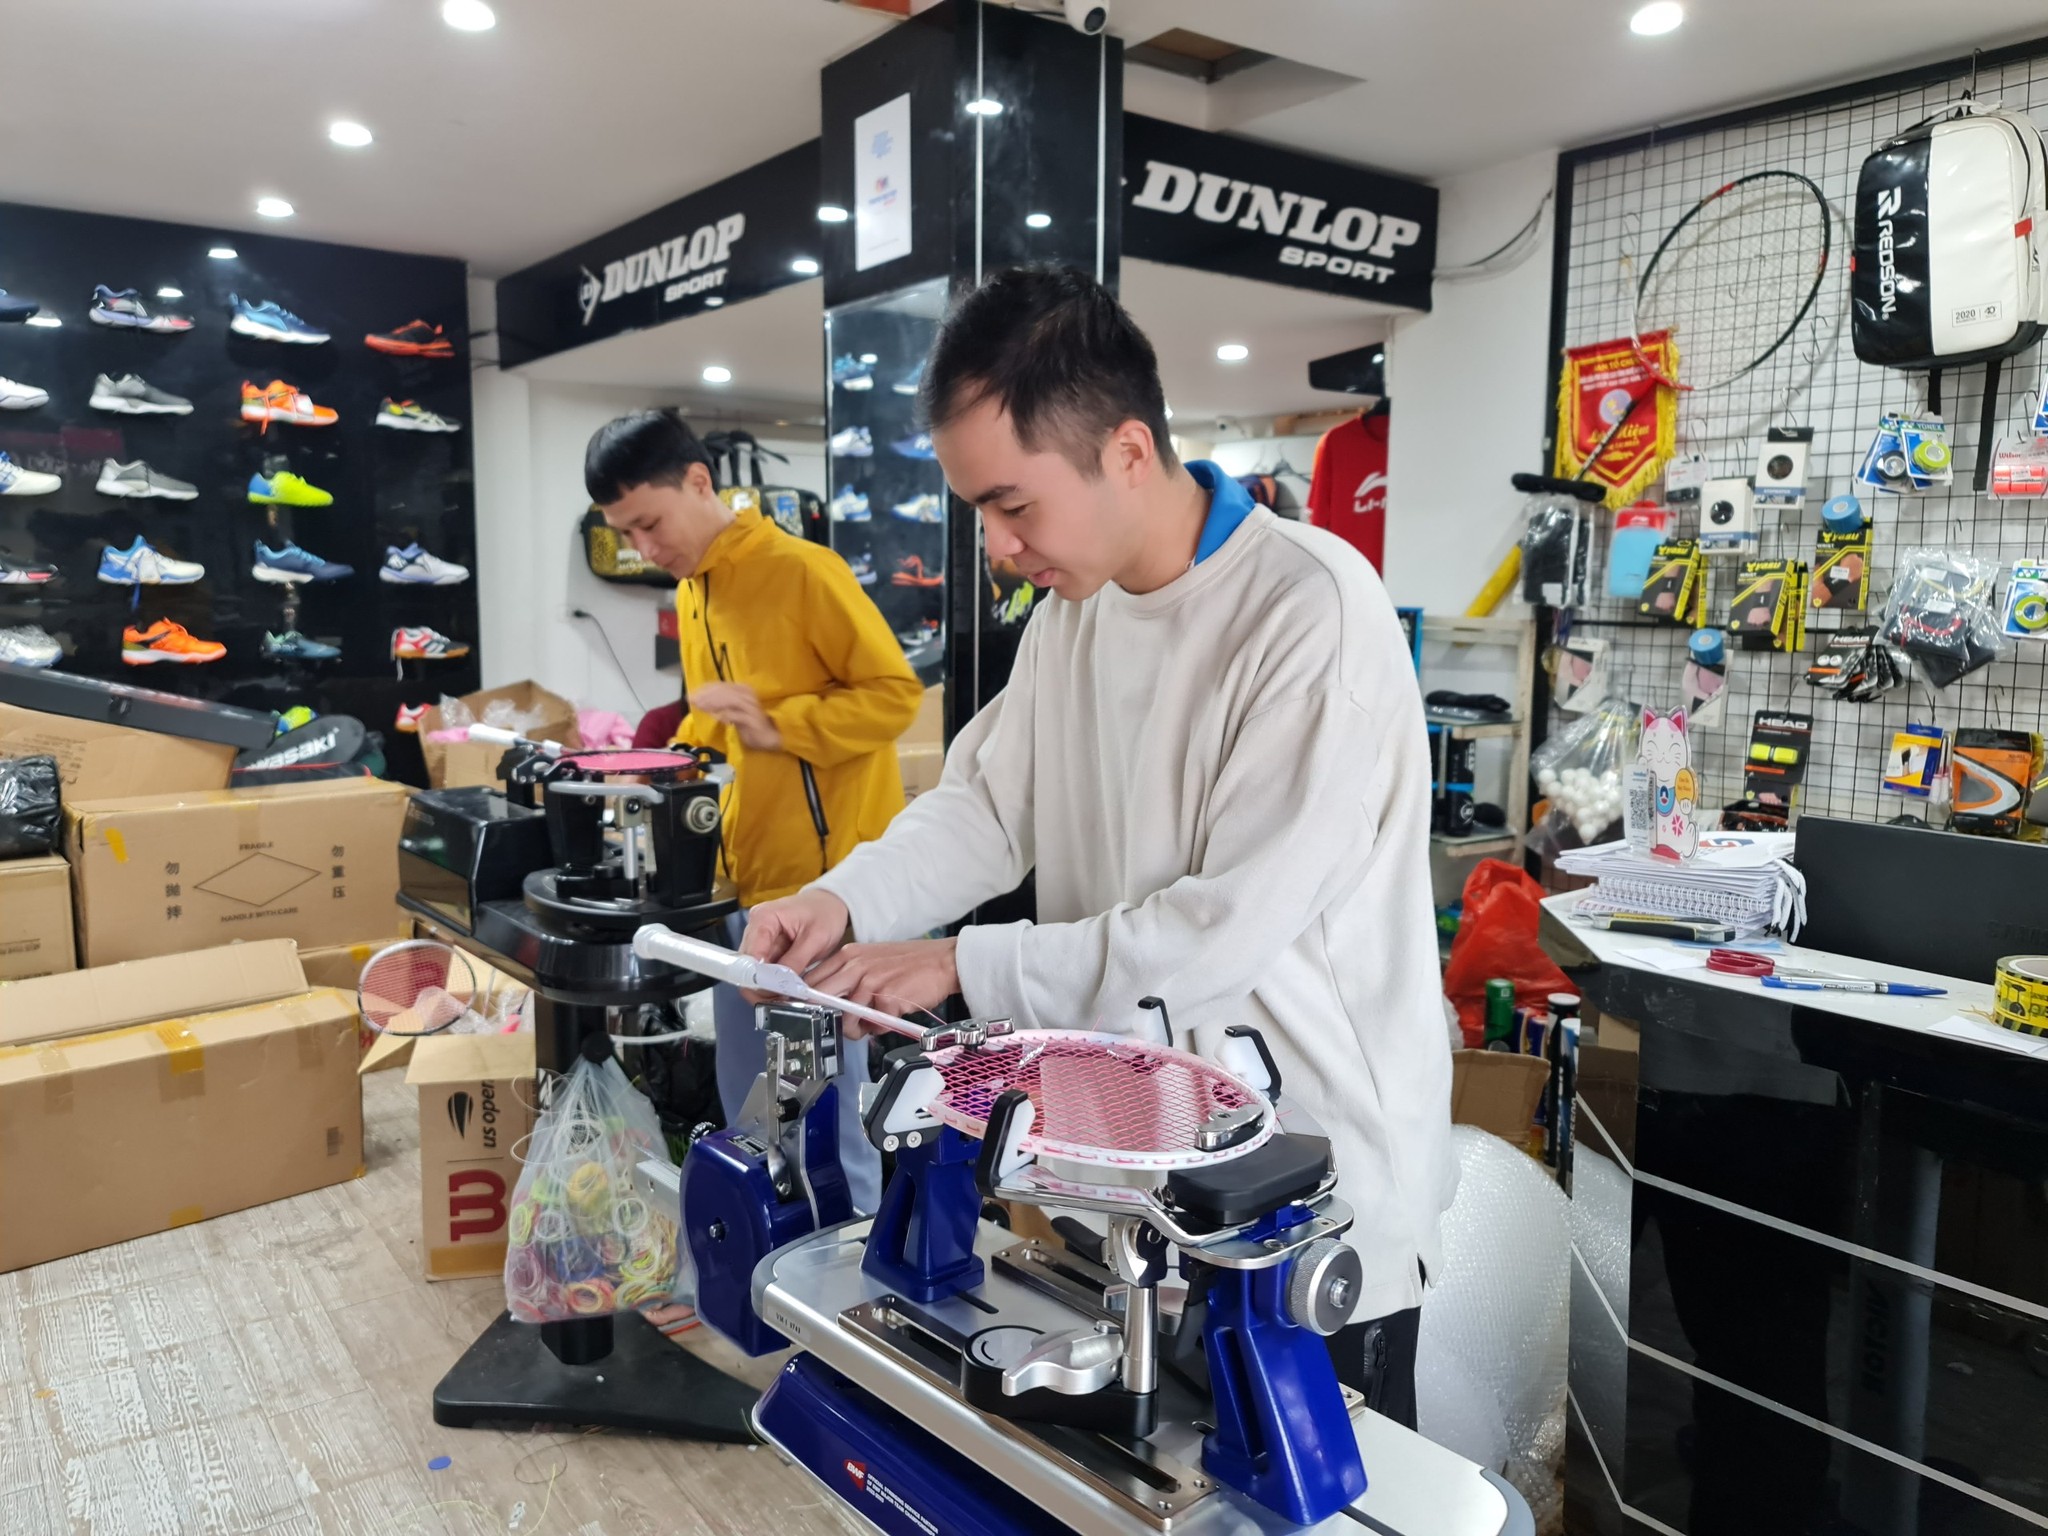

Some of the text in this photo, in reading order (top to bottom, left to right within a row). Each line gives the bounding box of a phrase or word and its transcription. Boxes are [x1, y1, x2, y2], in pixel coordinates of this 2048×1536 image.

[1132, 160, 1421, 258] DUNLOP
[601, 213, 745, 303] DUNLOP
[1279, 246, 1395, 284] SPORT
[1879, 219, 1897, 313] REDSON
[664, 267, 728, 303] SPORT
[1955, 309, 1976, 320] 2020
[1917, 422, 1943, 431] YONEX
[1758, 716, 1808, 730] HEAD
[245, 727, 340, 771] wasaki
[239, 841, 274, 851] FRAGILE
[221, 906, 298, 923] HANDLE WITH CARE
[482, 1126, 497, 1148] us
[846, 1461, 865, 1480] BWF
